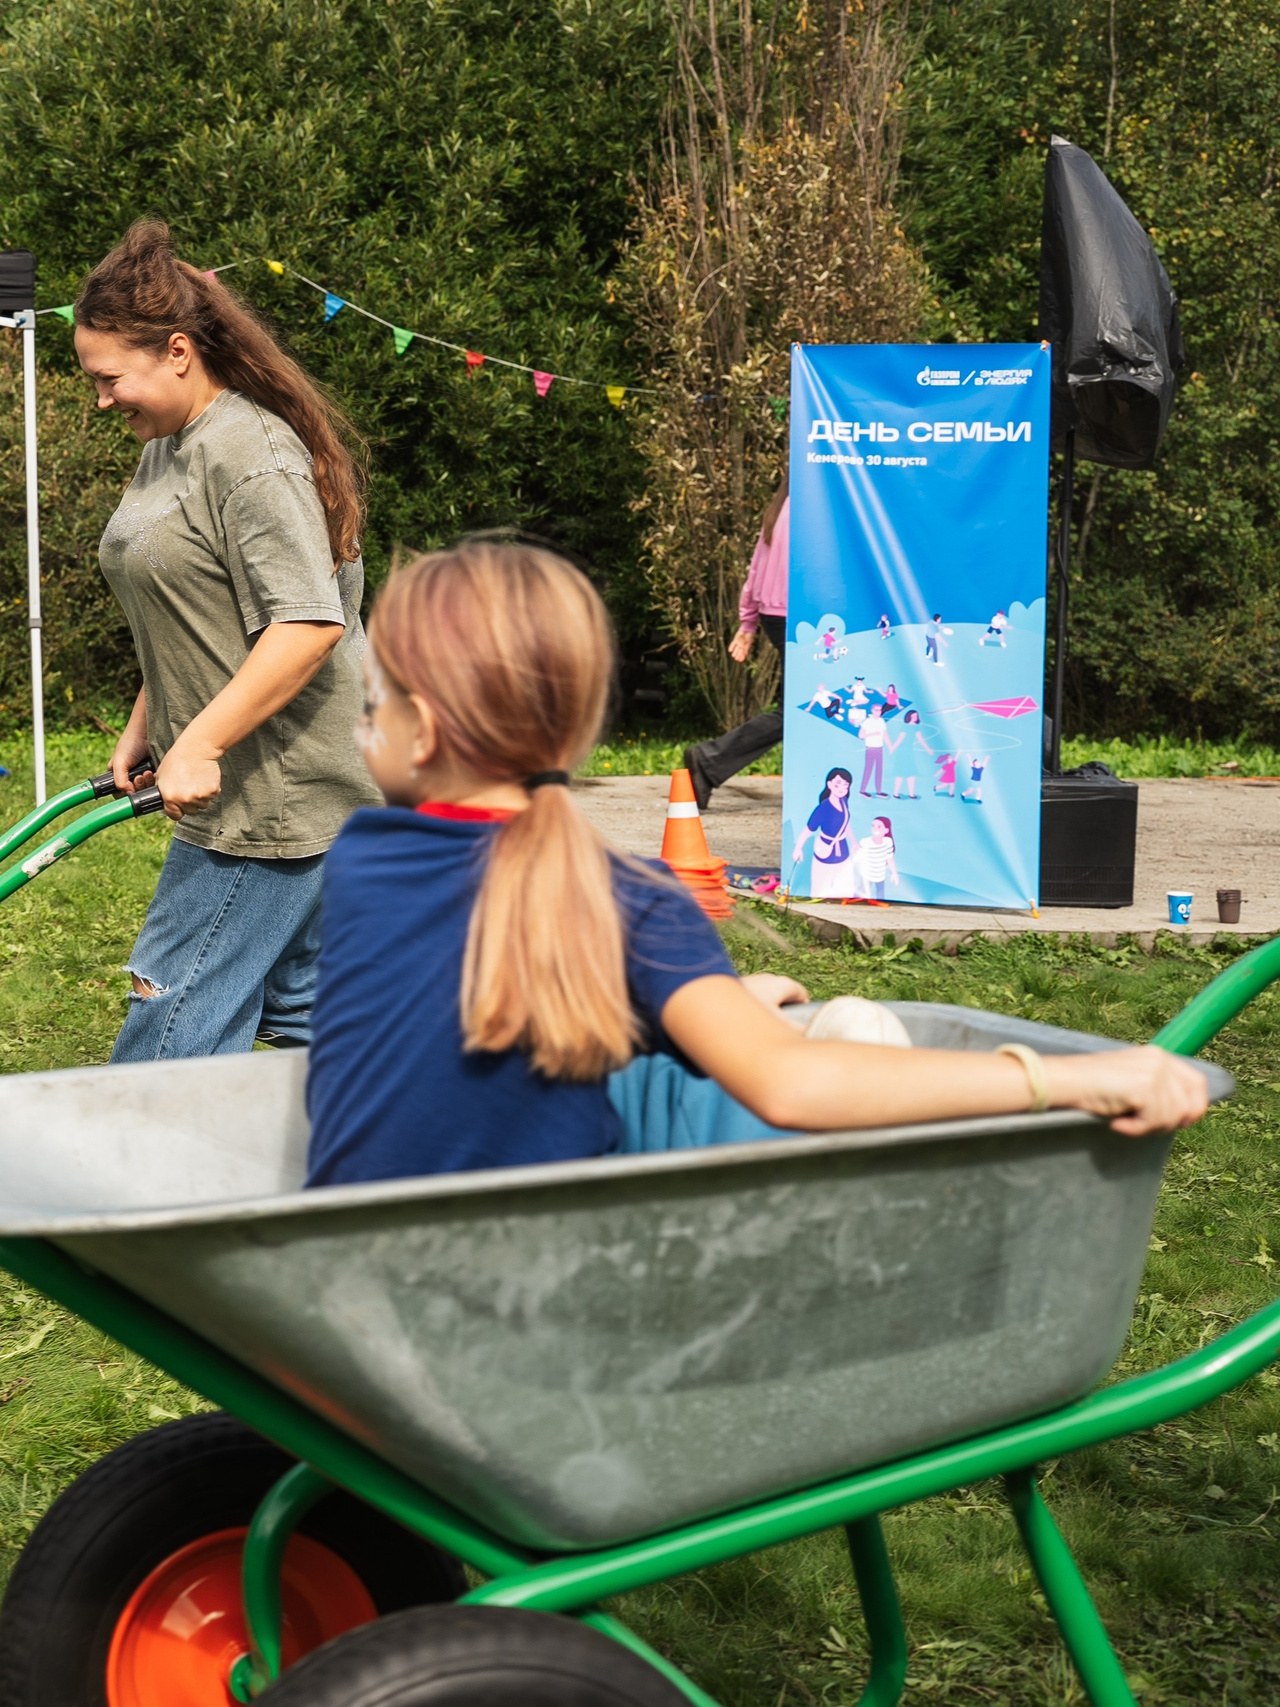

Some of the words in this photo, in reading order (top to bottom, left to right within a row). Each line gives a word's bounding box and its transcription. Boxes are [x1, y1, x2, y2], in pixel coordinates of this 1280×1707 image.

[980, 369, 1033, 378] ЭНЕРГИЯ
[974, 377, 984, 386] В
[984, 377, 1028, 386] ЛЮДЯХ
[807, 419, 900, 443] ДЕНЬ
[907, 421, 1032, 443] СЕМЬИ
[807, 452, 864, 466] Кемерово
[866, 454, 882, 466] 30
[883, 456, 927, 468] августа
